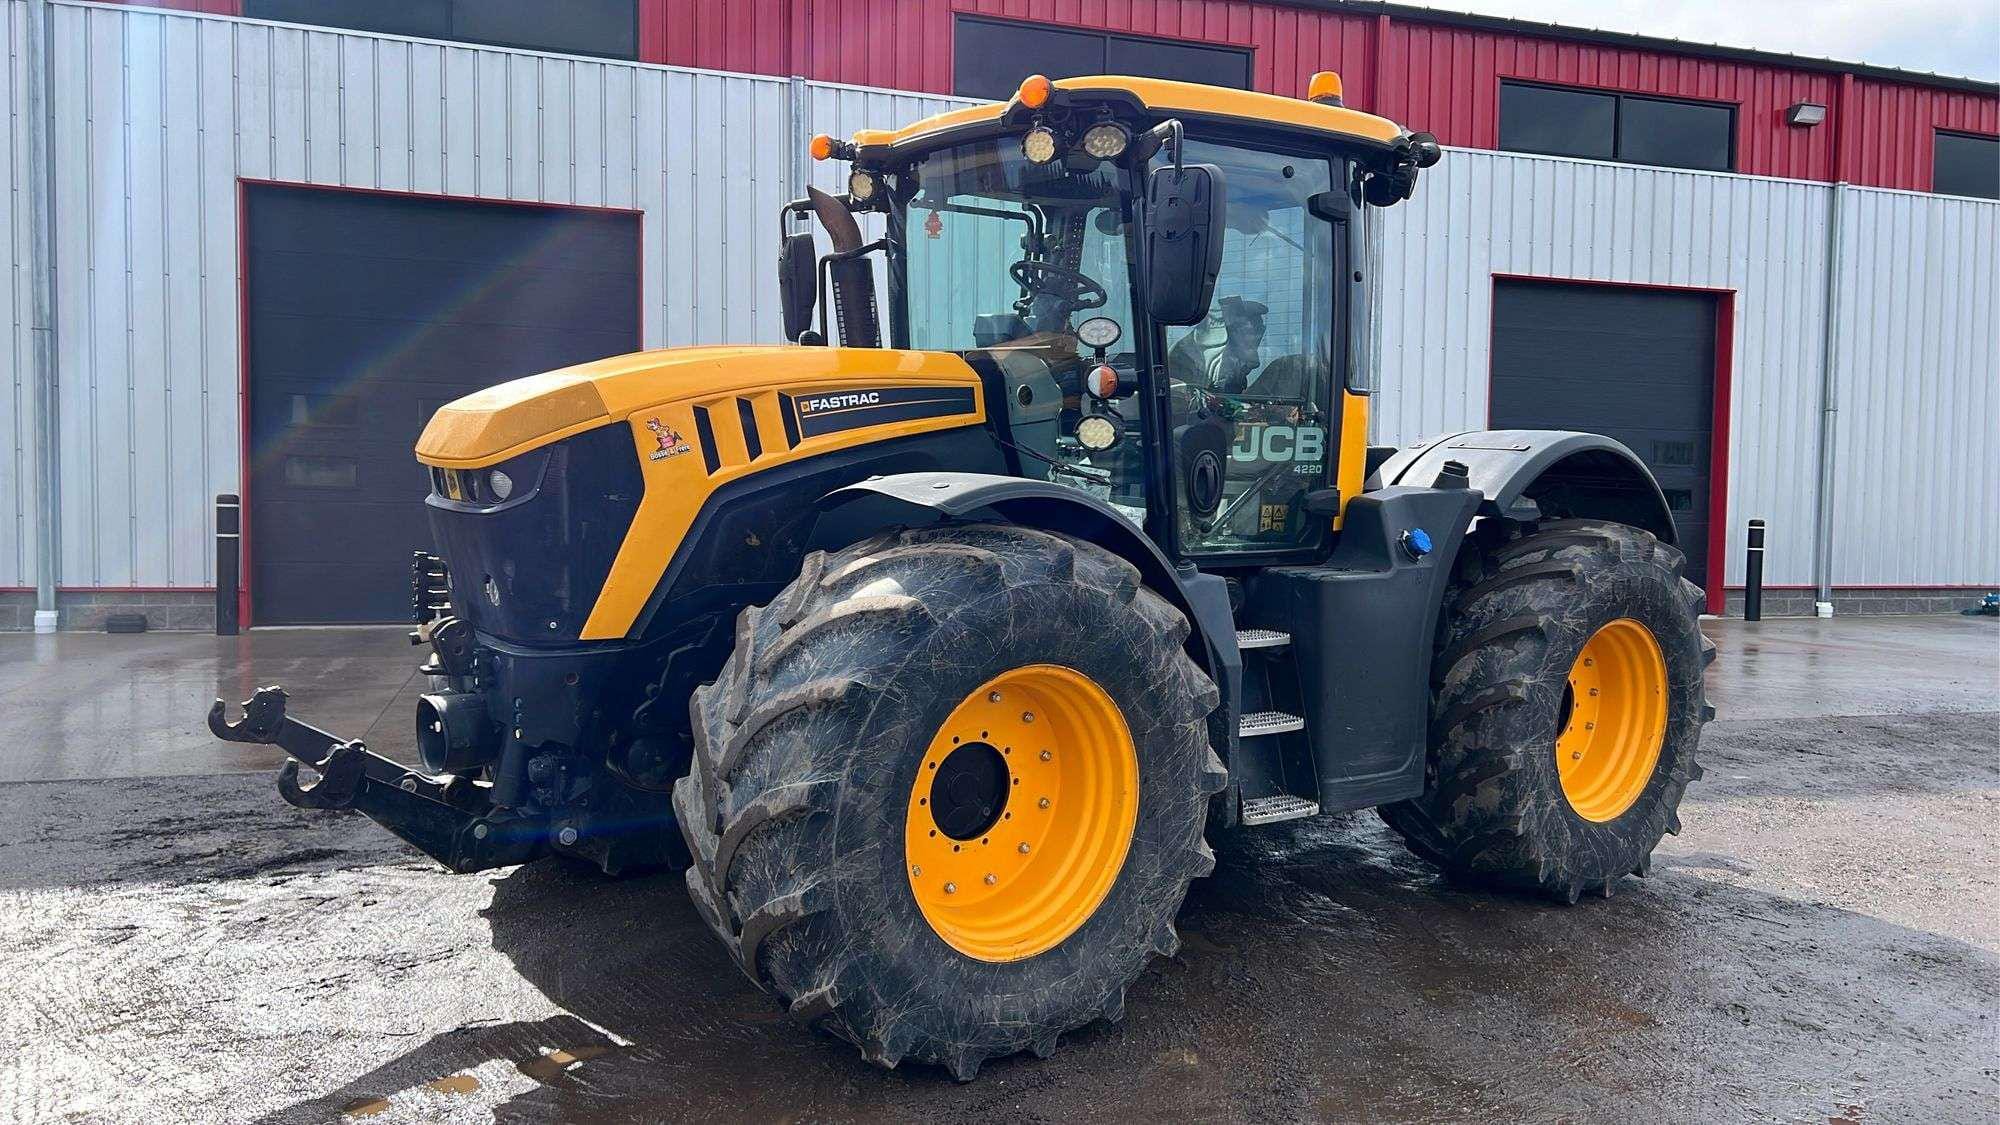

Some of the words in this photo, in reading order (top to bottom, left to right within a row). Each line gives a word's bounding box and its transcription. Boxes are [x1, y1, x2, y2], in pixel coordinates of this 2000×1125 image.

[809, 392, 880, 411] FASTRAC
[1232, 426, 1323, 462] JCB
[1293, 465, 1322, 474] 4220
